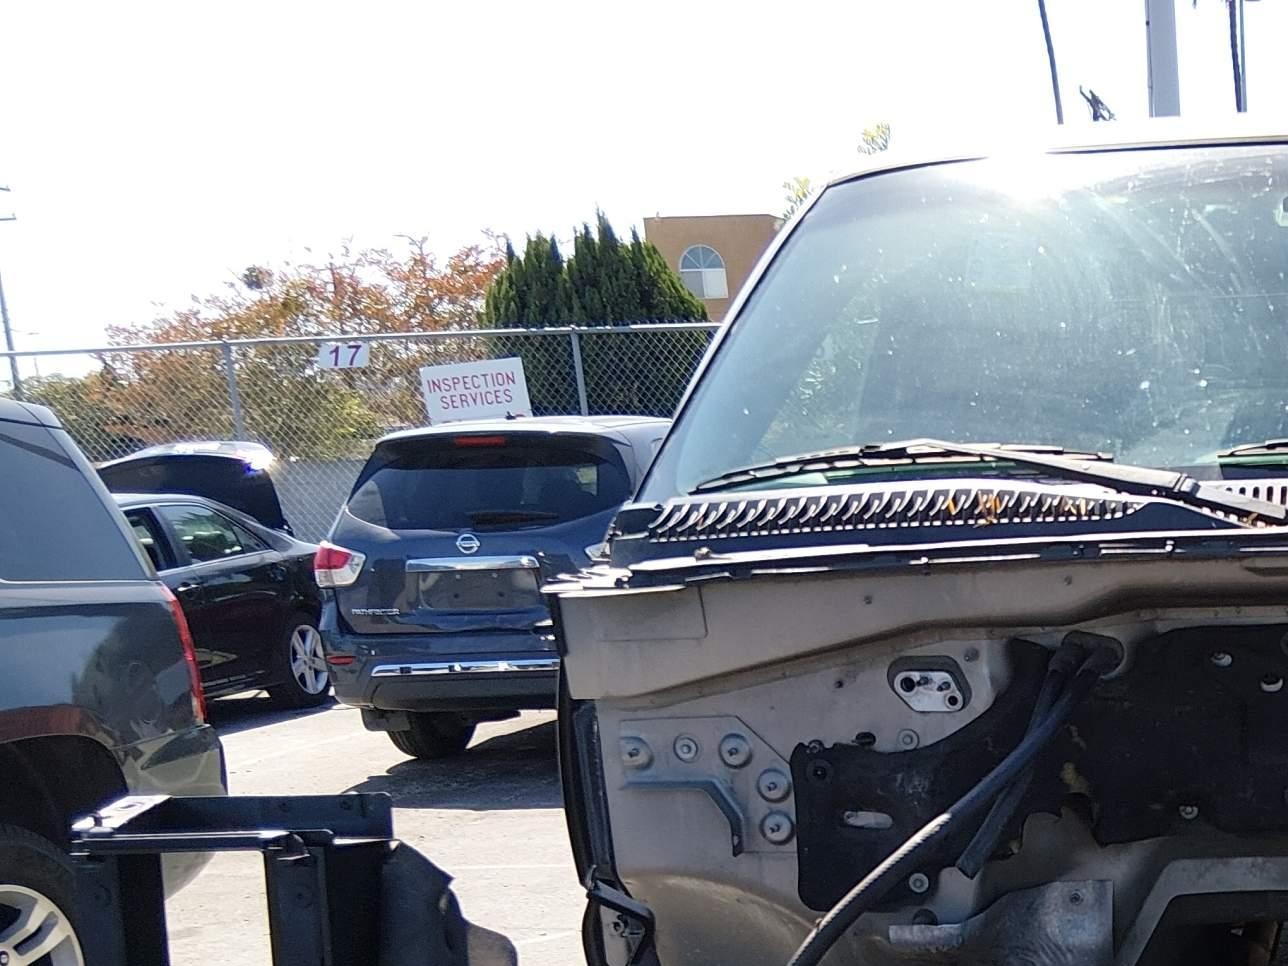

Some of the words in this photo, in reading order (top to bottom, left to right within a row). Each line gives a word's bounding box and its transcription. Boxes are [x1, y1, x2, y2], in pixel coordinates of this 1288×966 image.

[329, 345, 362, 367] 17
[427, 371, 516, 394] INSPECTION
[440, 388, 513, 410] SERVICES
